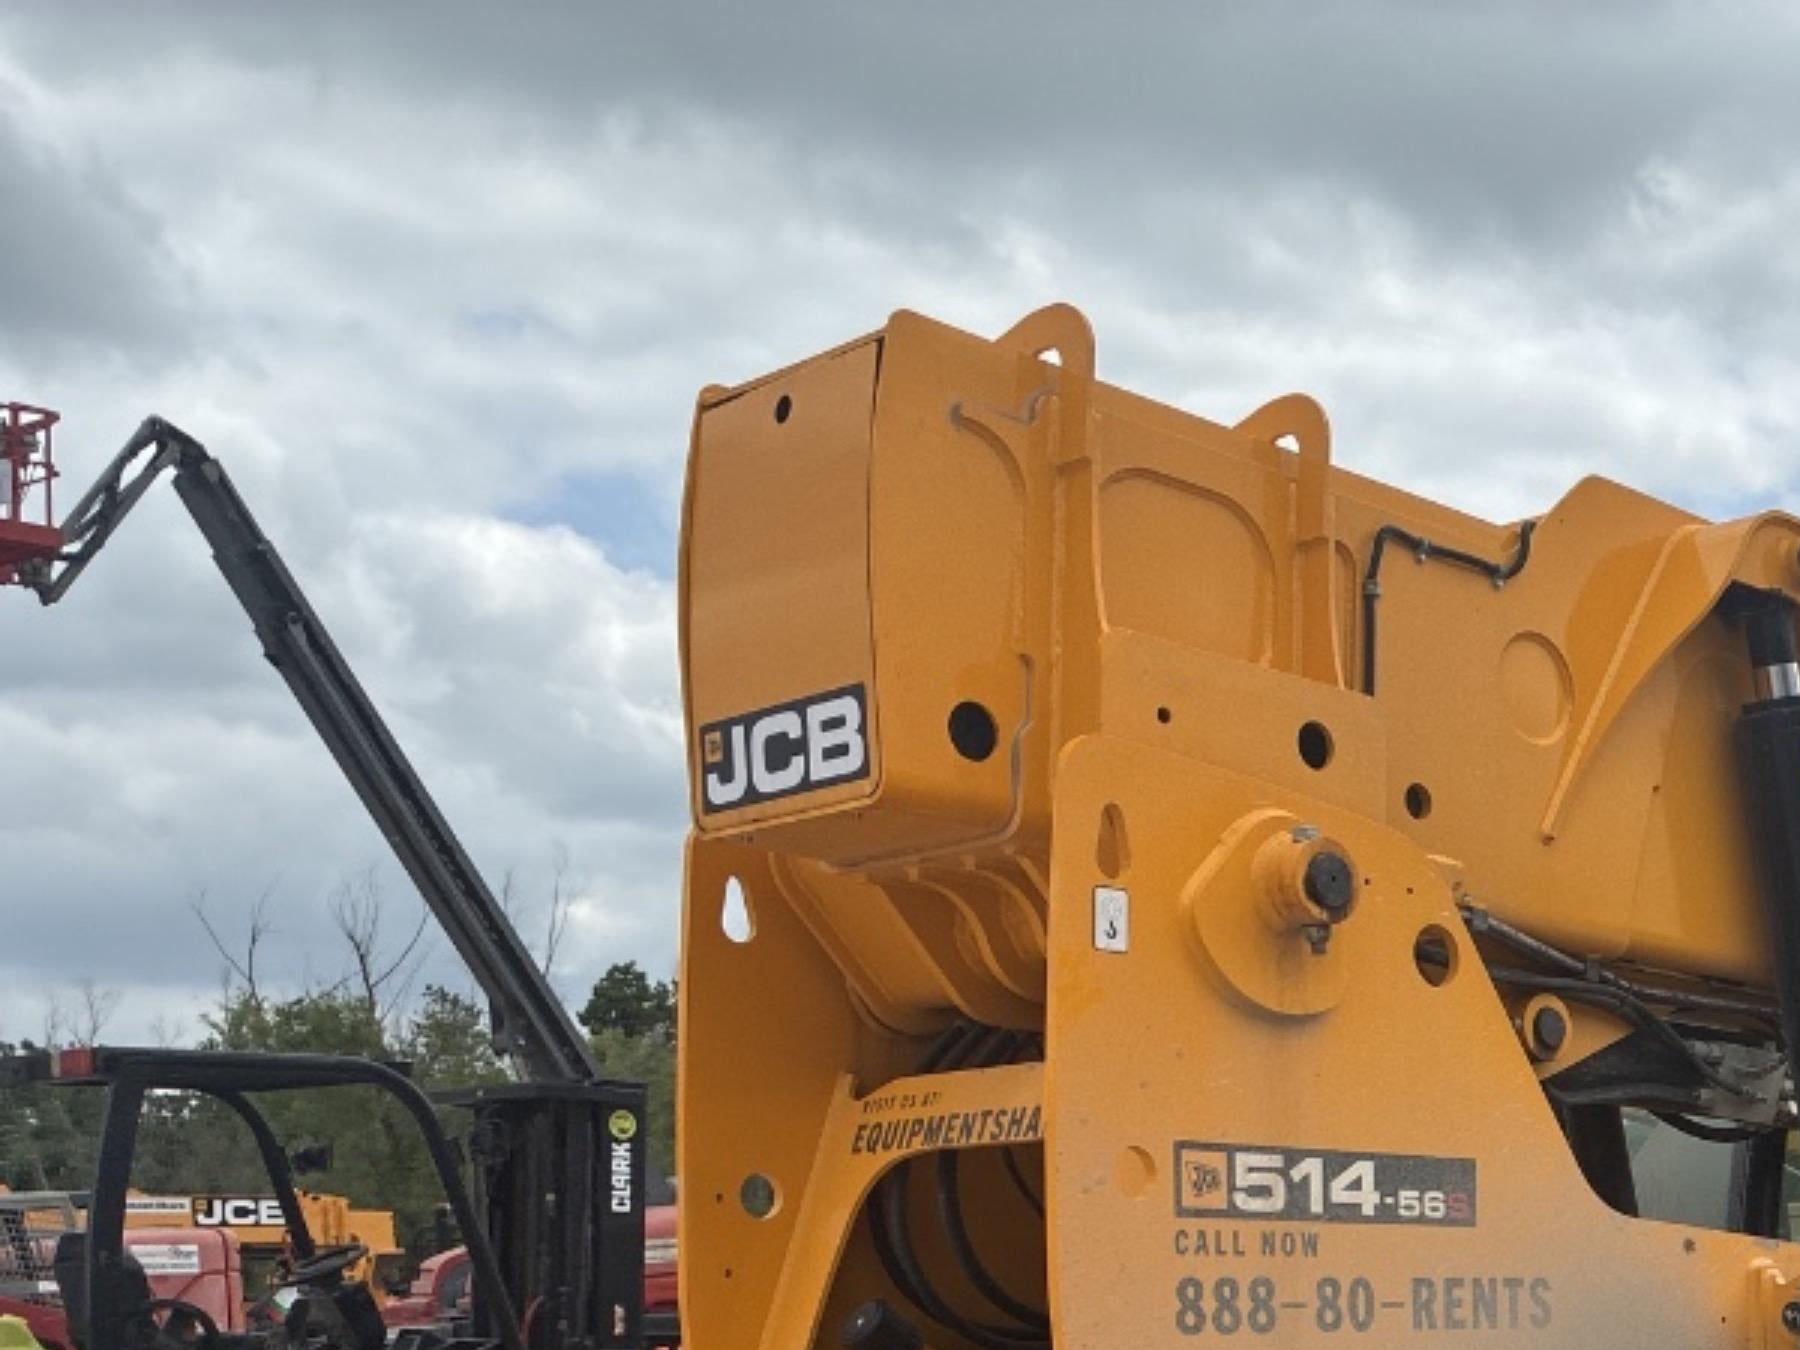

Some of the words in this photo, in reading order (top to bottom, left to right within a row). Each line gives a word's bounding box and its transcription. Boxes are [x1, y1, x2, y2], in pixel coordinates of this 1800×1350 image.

[704, 694, 867, 805] JCB
[851, 1104, 1044, 1156] EQUIPMENTSHA
[611, 1142, 631, 1213] CLARK
[1174, 1229, 1246, 1257] CALL
[1259, 1230, 1319, 1258] NOW
[1174, 1274, 1553, 1336] 888-80-RENTS
